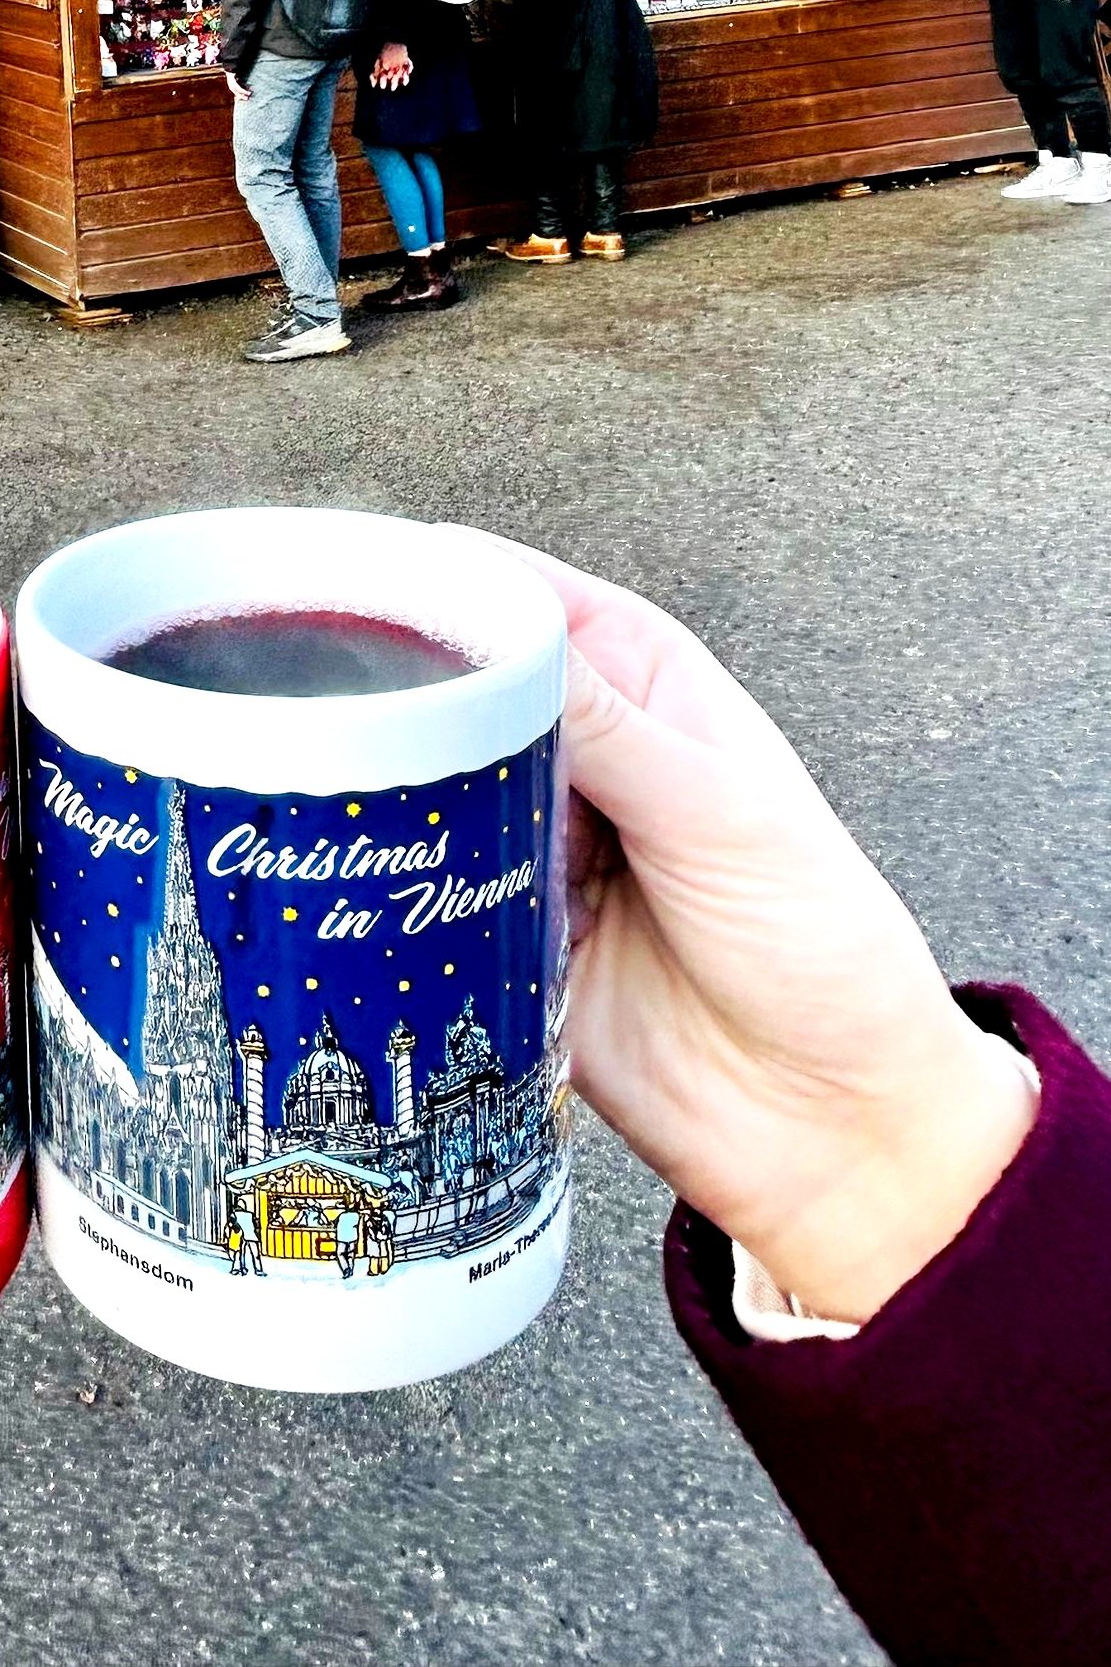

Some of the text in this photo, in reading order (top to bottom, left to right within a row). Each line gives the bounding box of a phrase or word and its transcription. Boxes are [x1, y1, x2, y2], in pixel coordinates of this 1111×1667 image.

[39, 758, 159, 858] Magic
[207, 823, 450, 881] Christmas
[317, 855, 540, 940] in Vienna
[79, 1215, 194, 1292] Stephansdom
